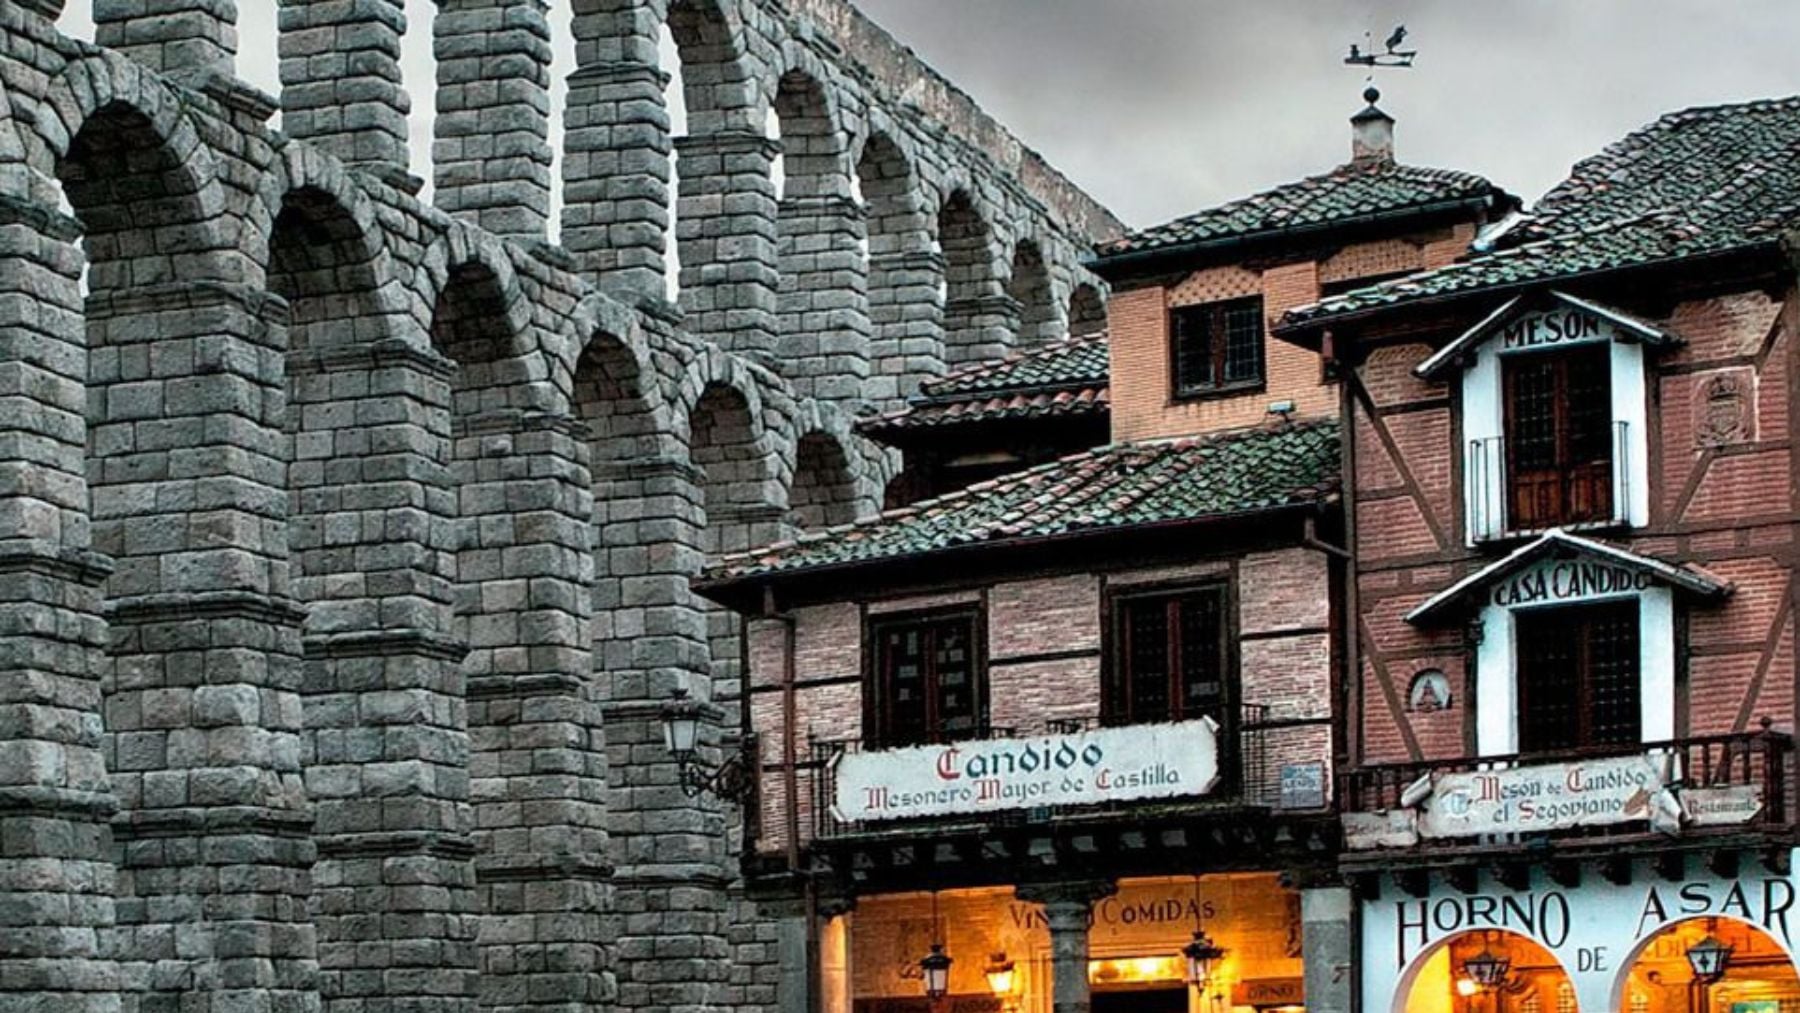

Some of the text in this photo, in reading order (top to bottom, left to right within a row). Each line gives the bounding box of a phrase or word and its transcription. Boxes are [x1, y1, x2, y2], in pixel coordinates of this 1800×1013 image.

[1503, 312, 1600, 348] MESON
[1494, 562, 1650, 606] CASA CANDIDO
[936, 739, 1103, 779] Candido
[865, 764, 1180, 811] Mesonero Mayor de Castilla
[1546, 783, 1562, 795] de
[1566, 766, 1647, 793] Candido
[1493, 798, 1622, 825] el Segoviano
[1102, 897, 1216, 925] COMIDAS
[1396, 878, 1796, 974] HORNO DE ASAR
